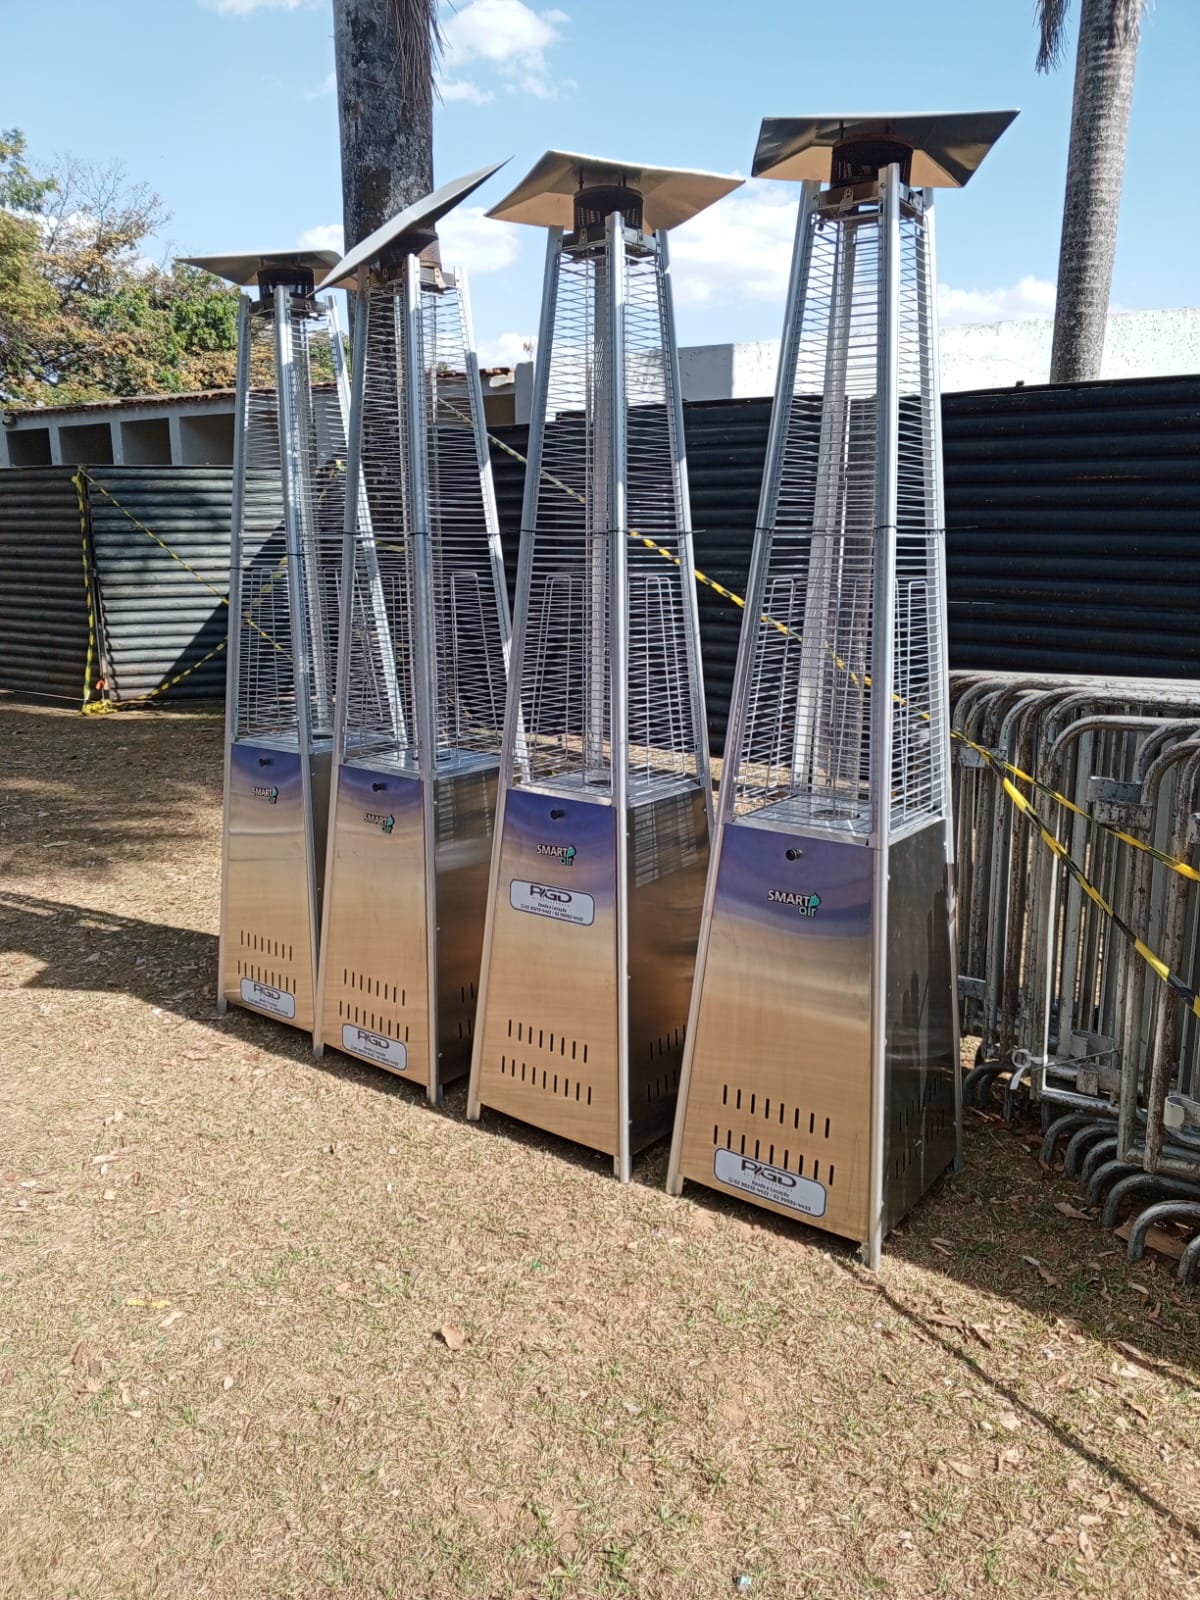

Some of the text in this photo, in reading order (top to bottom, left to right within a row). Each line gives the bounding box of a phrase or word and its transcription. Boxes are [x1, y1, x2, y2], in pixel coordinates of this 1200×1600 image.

[536, 844, 568, 858] SMART
[767, 889, 811, 907] SMART
[799, 905, 817, 918] air
